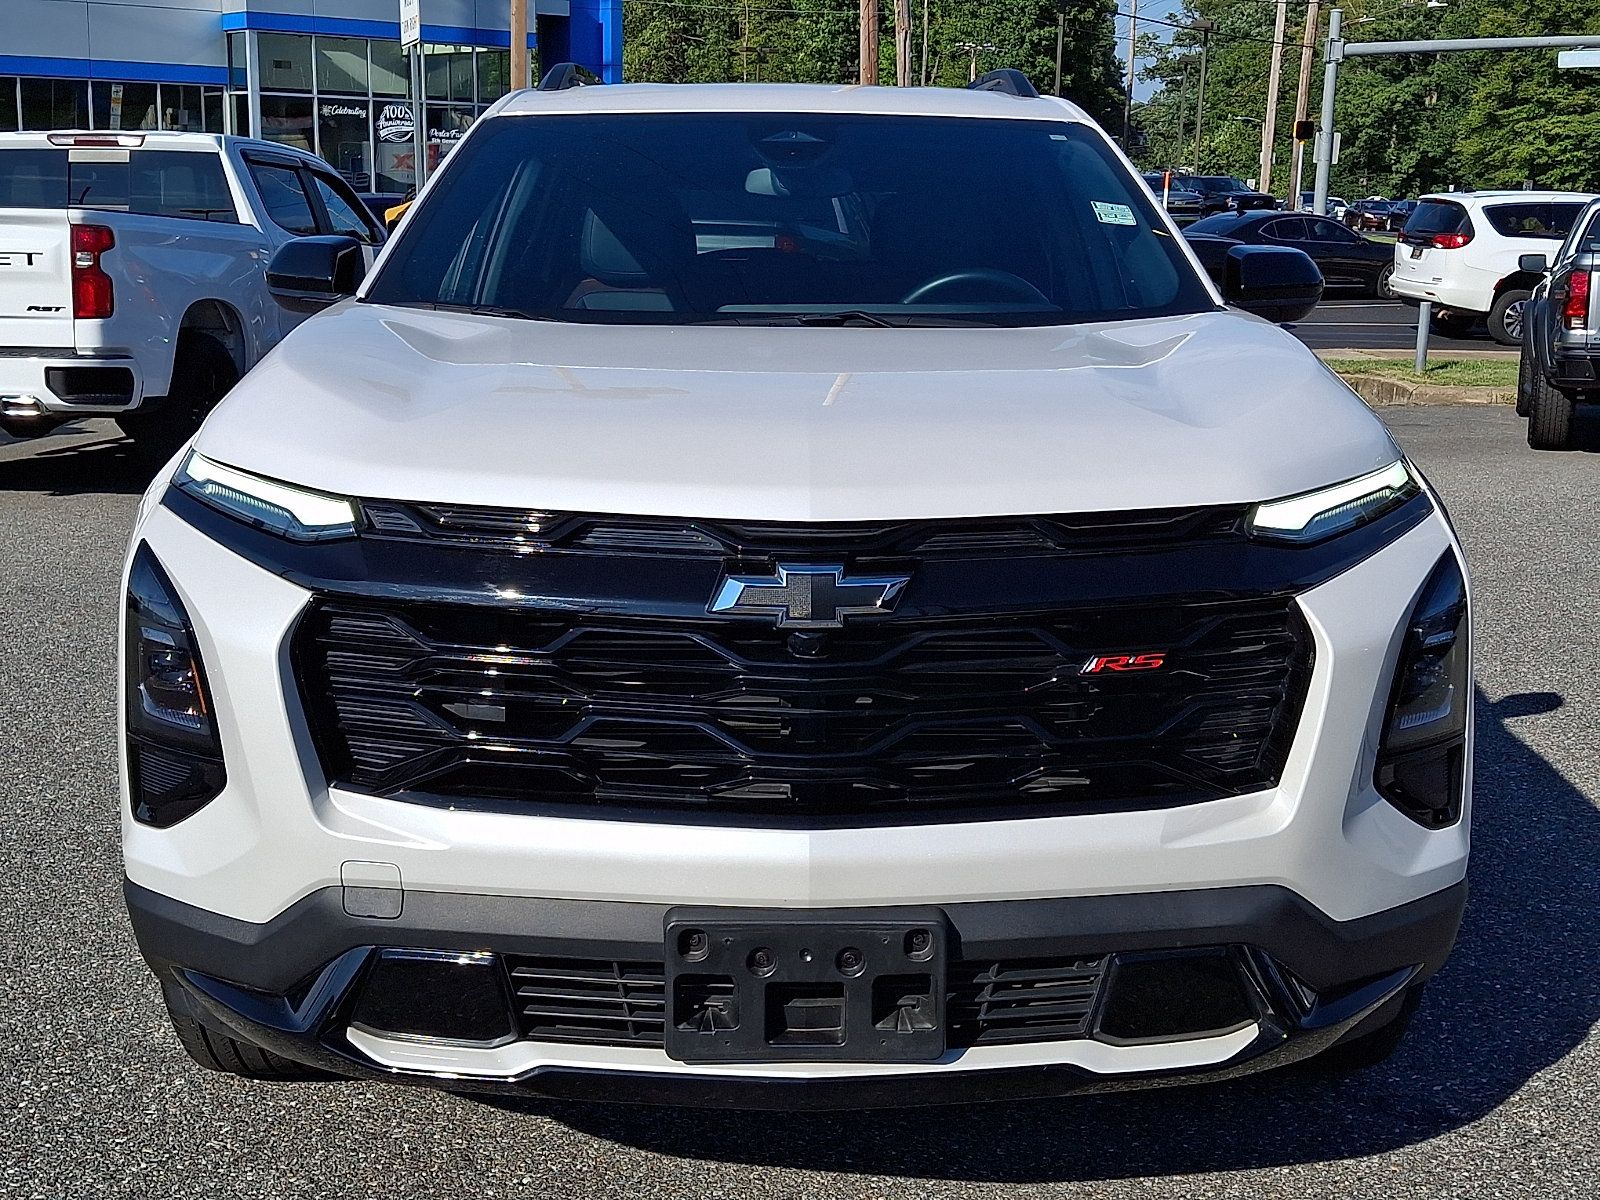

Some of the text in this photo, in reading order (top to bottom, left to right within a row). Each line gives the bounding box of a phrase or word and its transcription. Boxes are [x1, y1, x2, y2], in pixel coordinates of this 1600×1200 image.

[331, 104, 367, 119] Celebrating
[376, 117, 414, 129] Anniversar
[1083, 652, 1167, 673] RS
